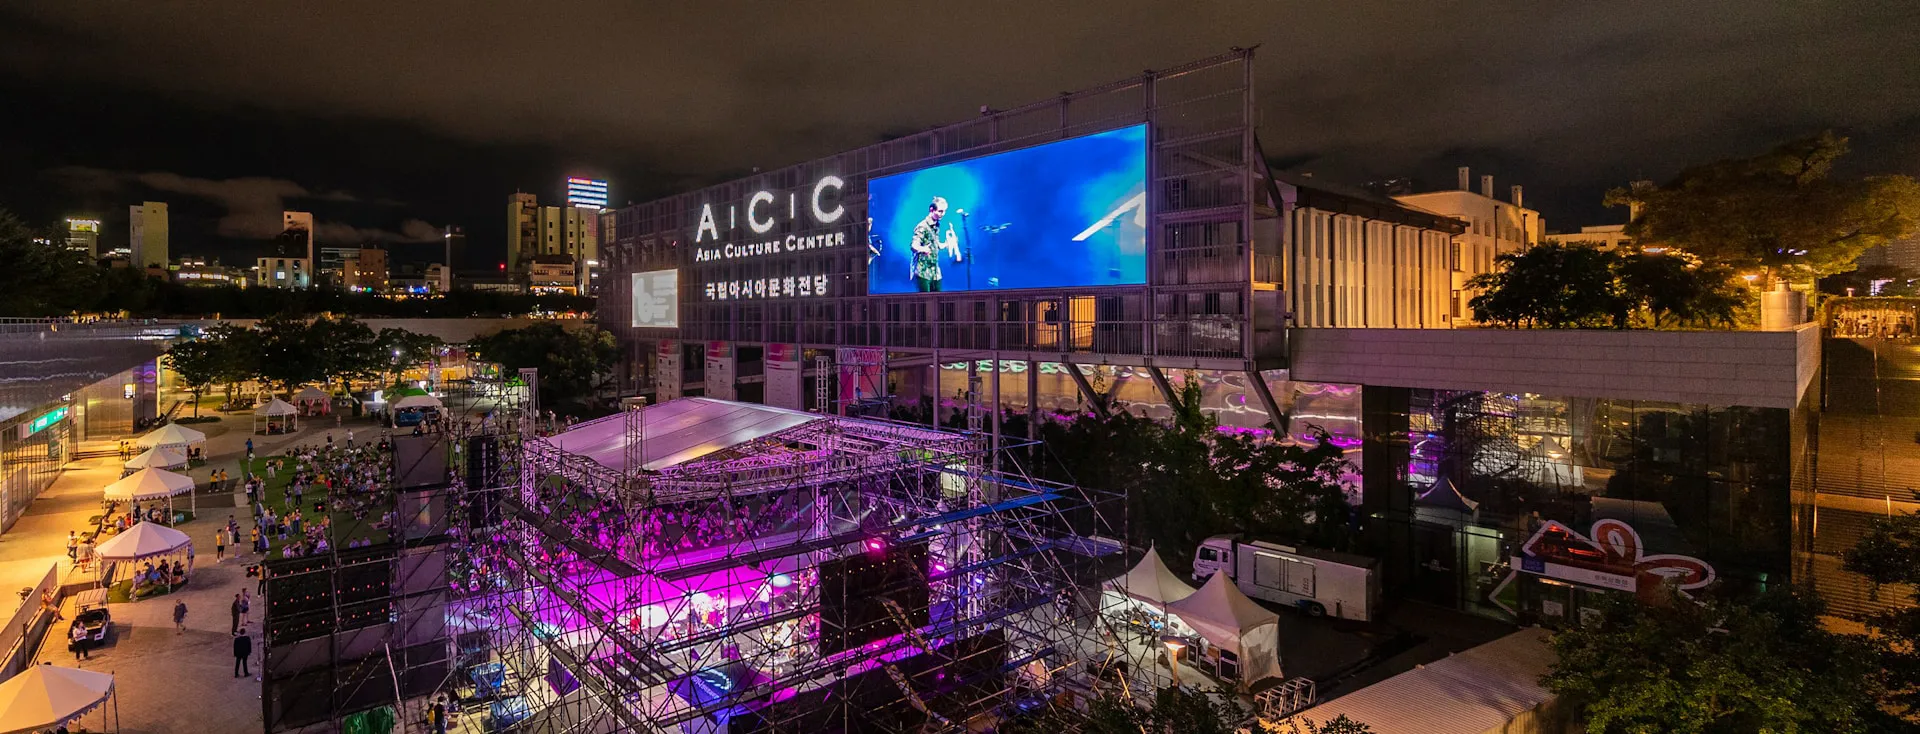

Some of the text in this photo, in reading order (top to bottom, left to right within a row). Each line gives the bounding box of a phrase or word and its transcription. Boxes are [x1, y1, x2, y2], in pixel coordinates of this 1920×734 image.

[725, 243, 780, 258] CULTURE
[785, 232, 845, 251] CENTER
[705, 274, 828, 300] 국립아시아문화전당
